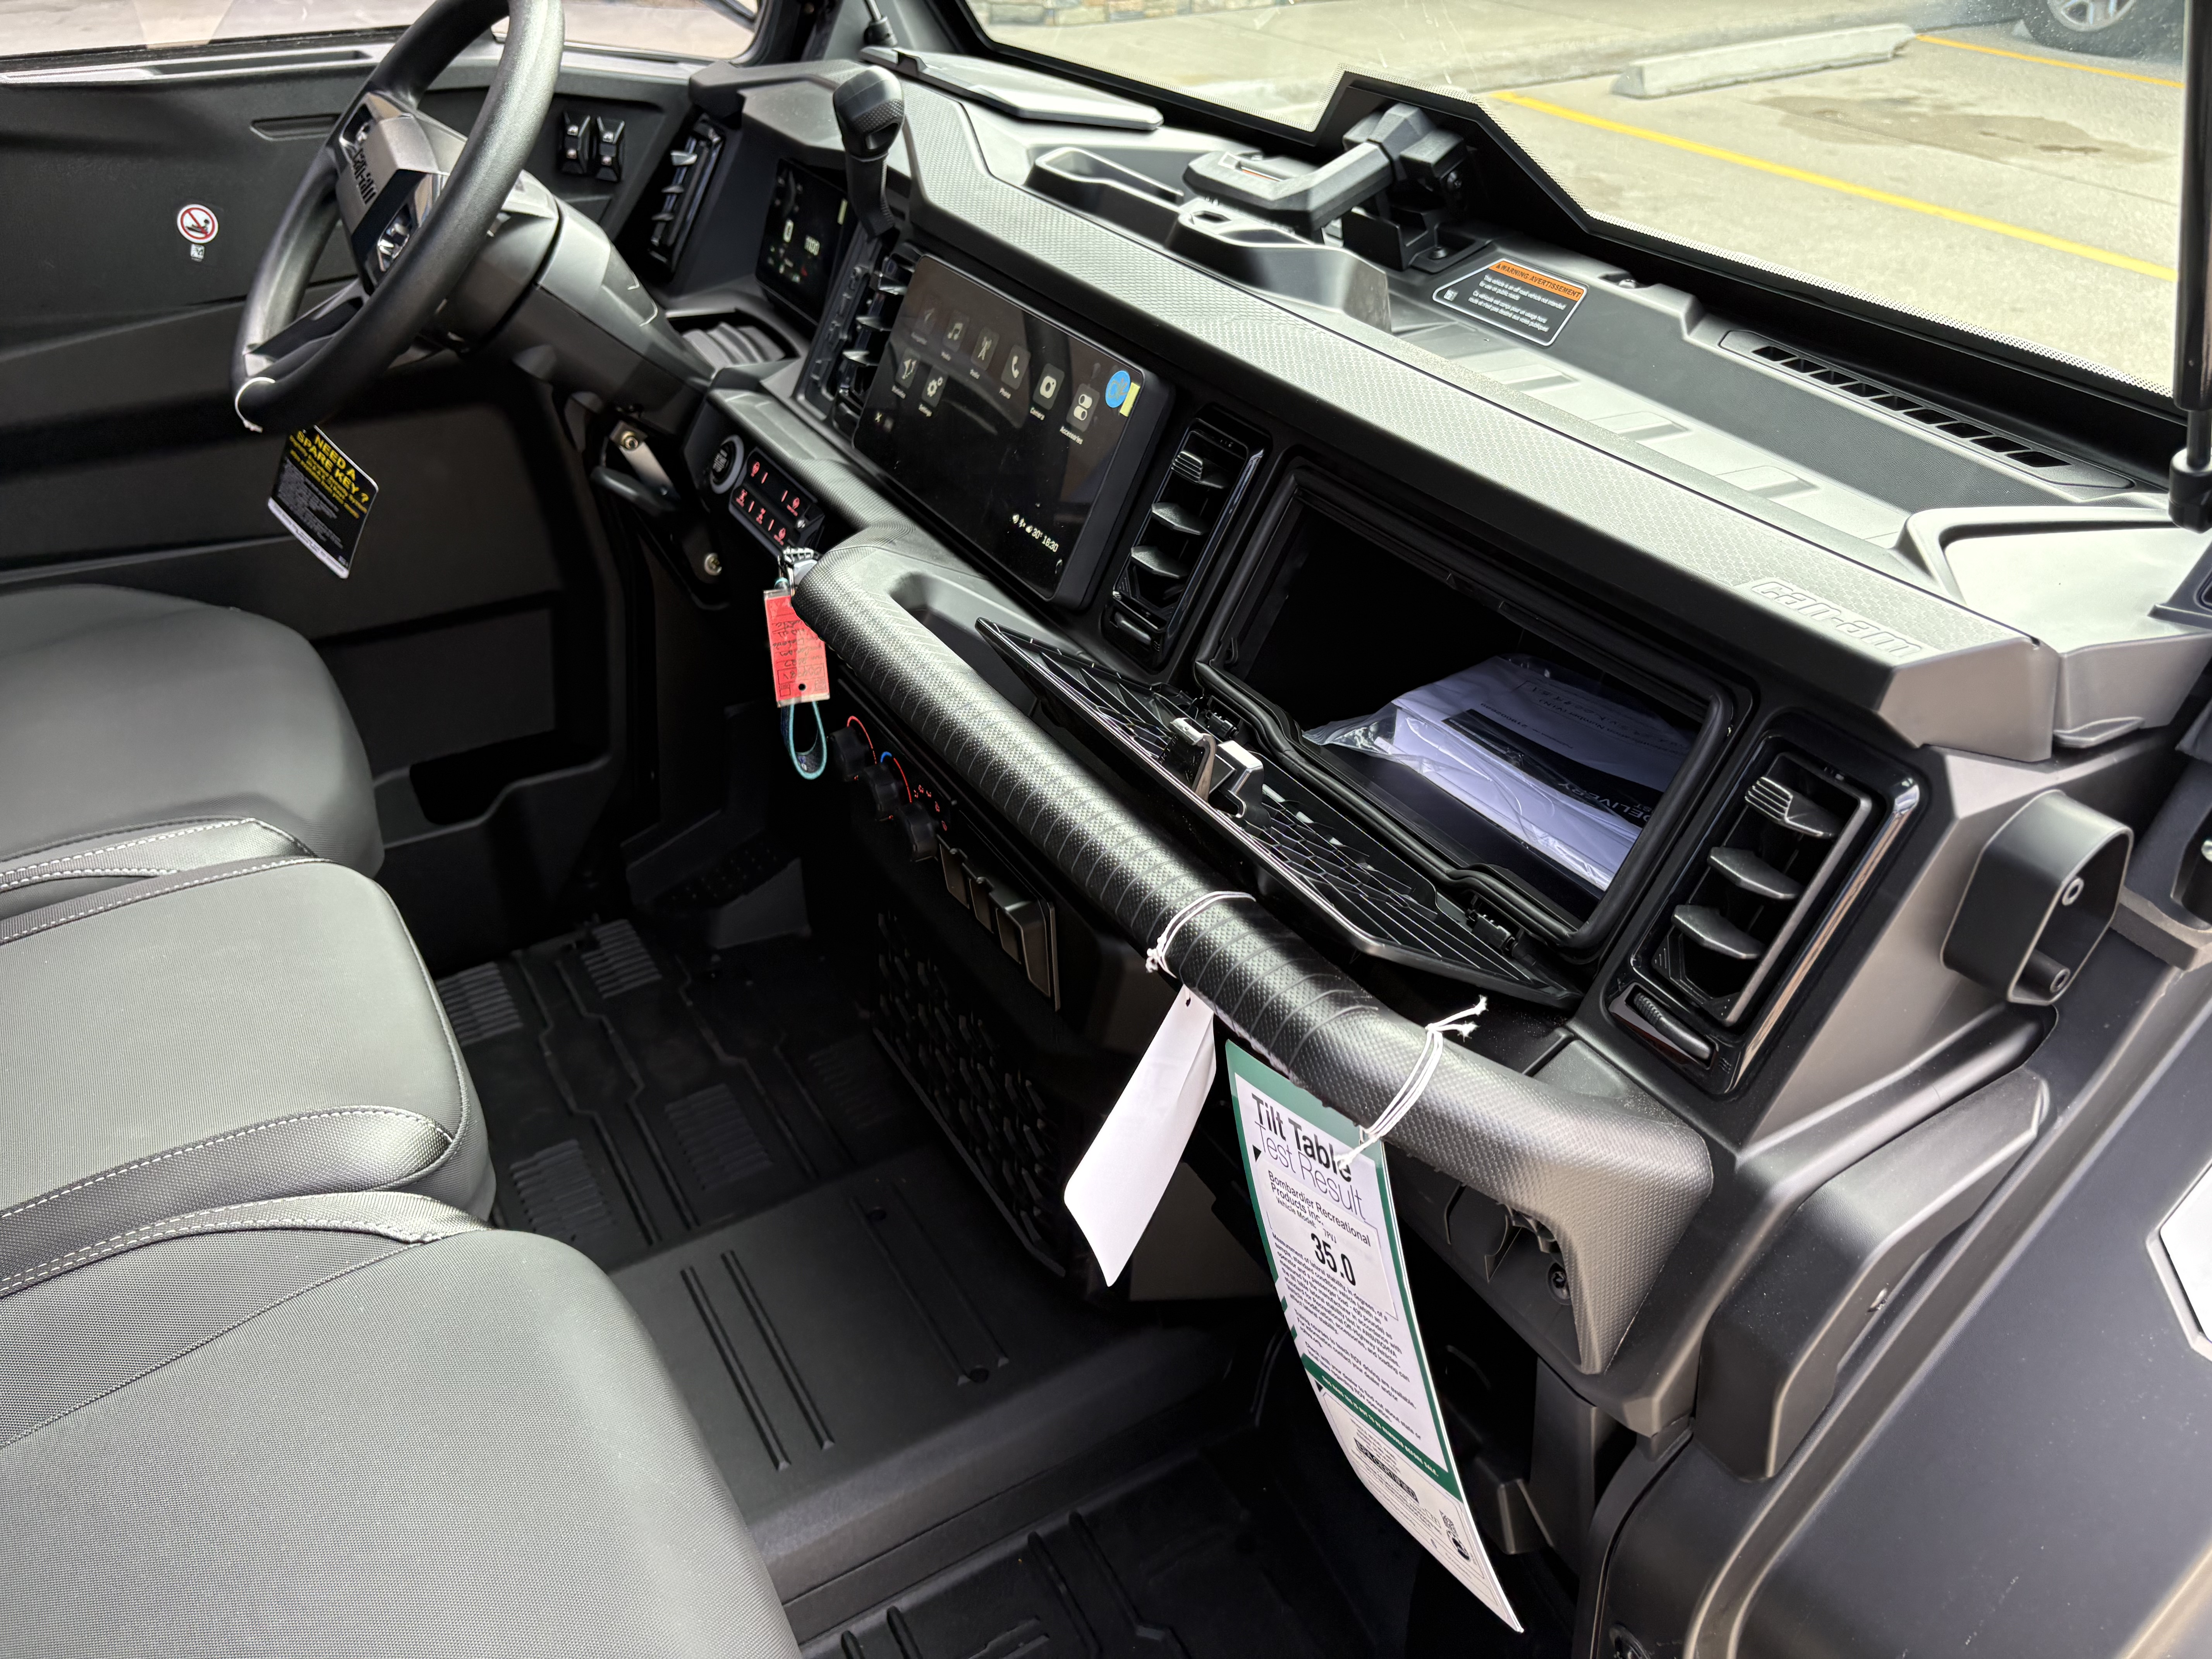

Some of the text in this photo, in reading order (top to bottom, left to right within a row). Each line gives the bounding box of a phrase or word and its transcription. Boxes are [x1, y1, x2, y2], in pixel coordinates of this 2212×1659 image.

[297, 430, 333, 472] SPARE
[335, 469, 359, 494] KEY
[315, 433, 356, 481] NEED A
[1568, 711, 1605, 730] Number
[1252, 1093, 1352, 1182] Tilt Table
[1255, 1121, 1366, 1220] Test Result
[1268, 1170, 1370, 1247] Bombardier Recreational
[1271, 1182, 1323, 1225] Products inc.
[1276, 1197, 1296, 1214] Vehicle
[1297, 1210, 1316, 1228] Model:
[1311, 1233, 1355, 1286] 35.0
[1298, 1267, 1306, 1276] and
[1363, 1315, 1384, 1335] pounds)
[1310, 1260, 1325, 1276] lateral
[1347, 1288, 1353, 1296] in
[1353, 1293, 1376, 1314] degrees,
[1302, 1276, 1308, 1285] by
[1390, 1342, 1402, 1354] with
[1368, 1348, 1377, 1357] and
[1378, 1354, 1398, 1374] loading
[1399, 1372, 1410, 1382] can
[1373, 1456, 1416, 1499] CERTIFIED
